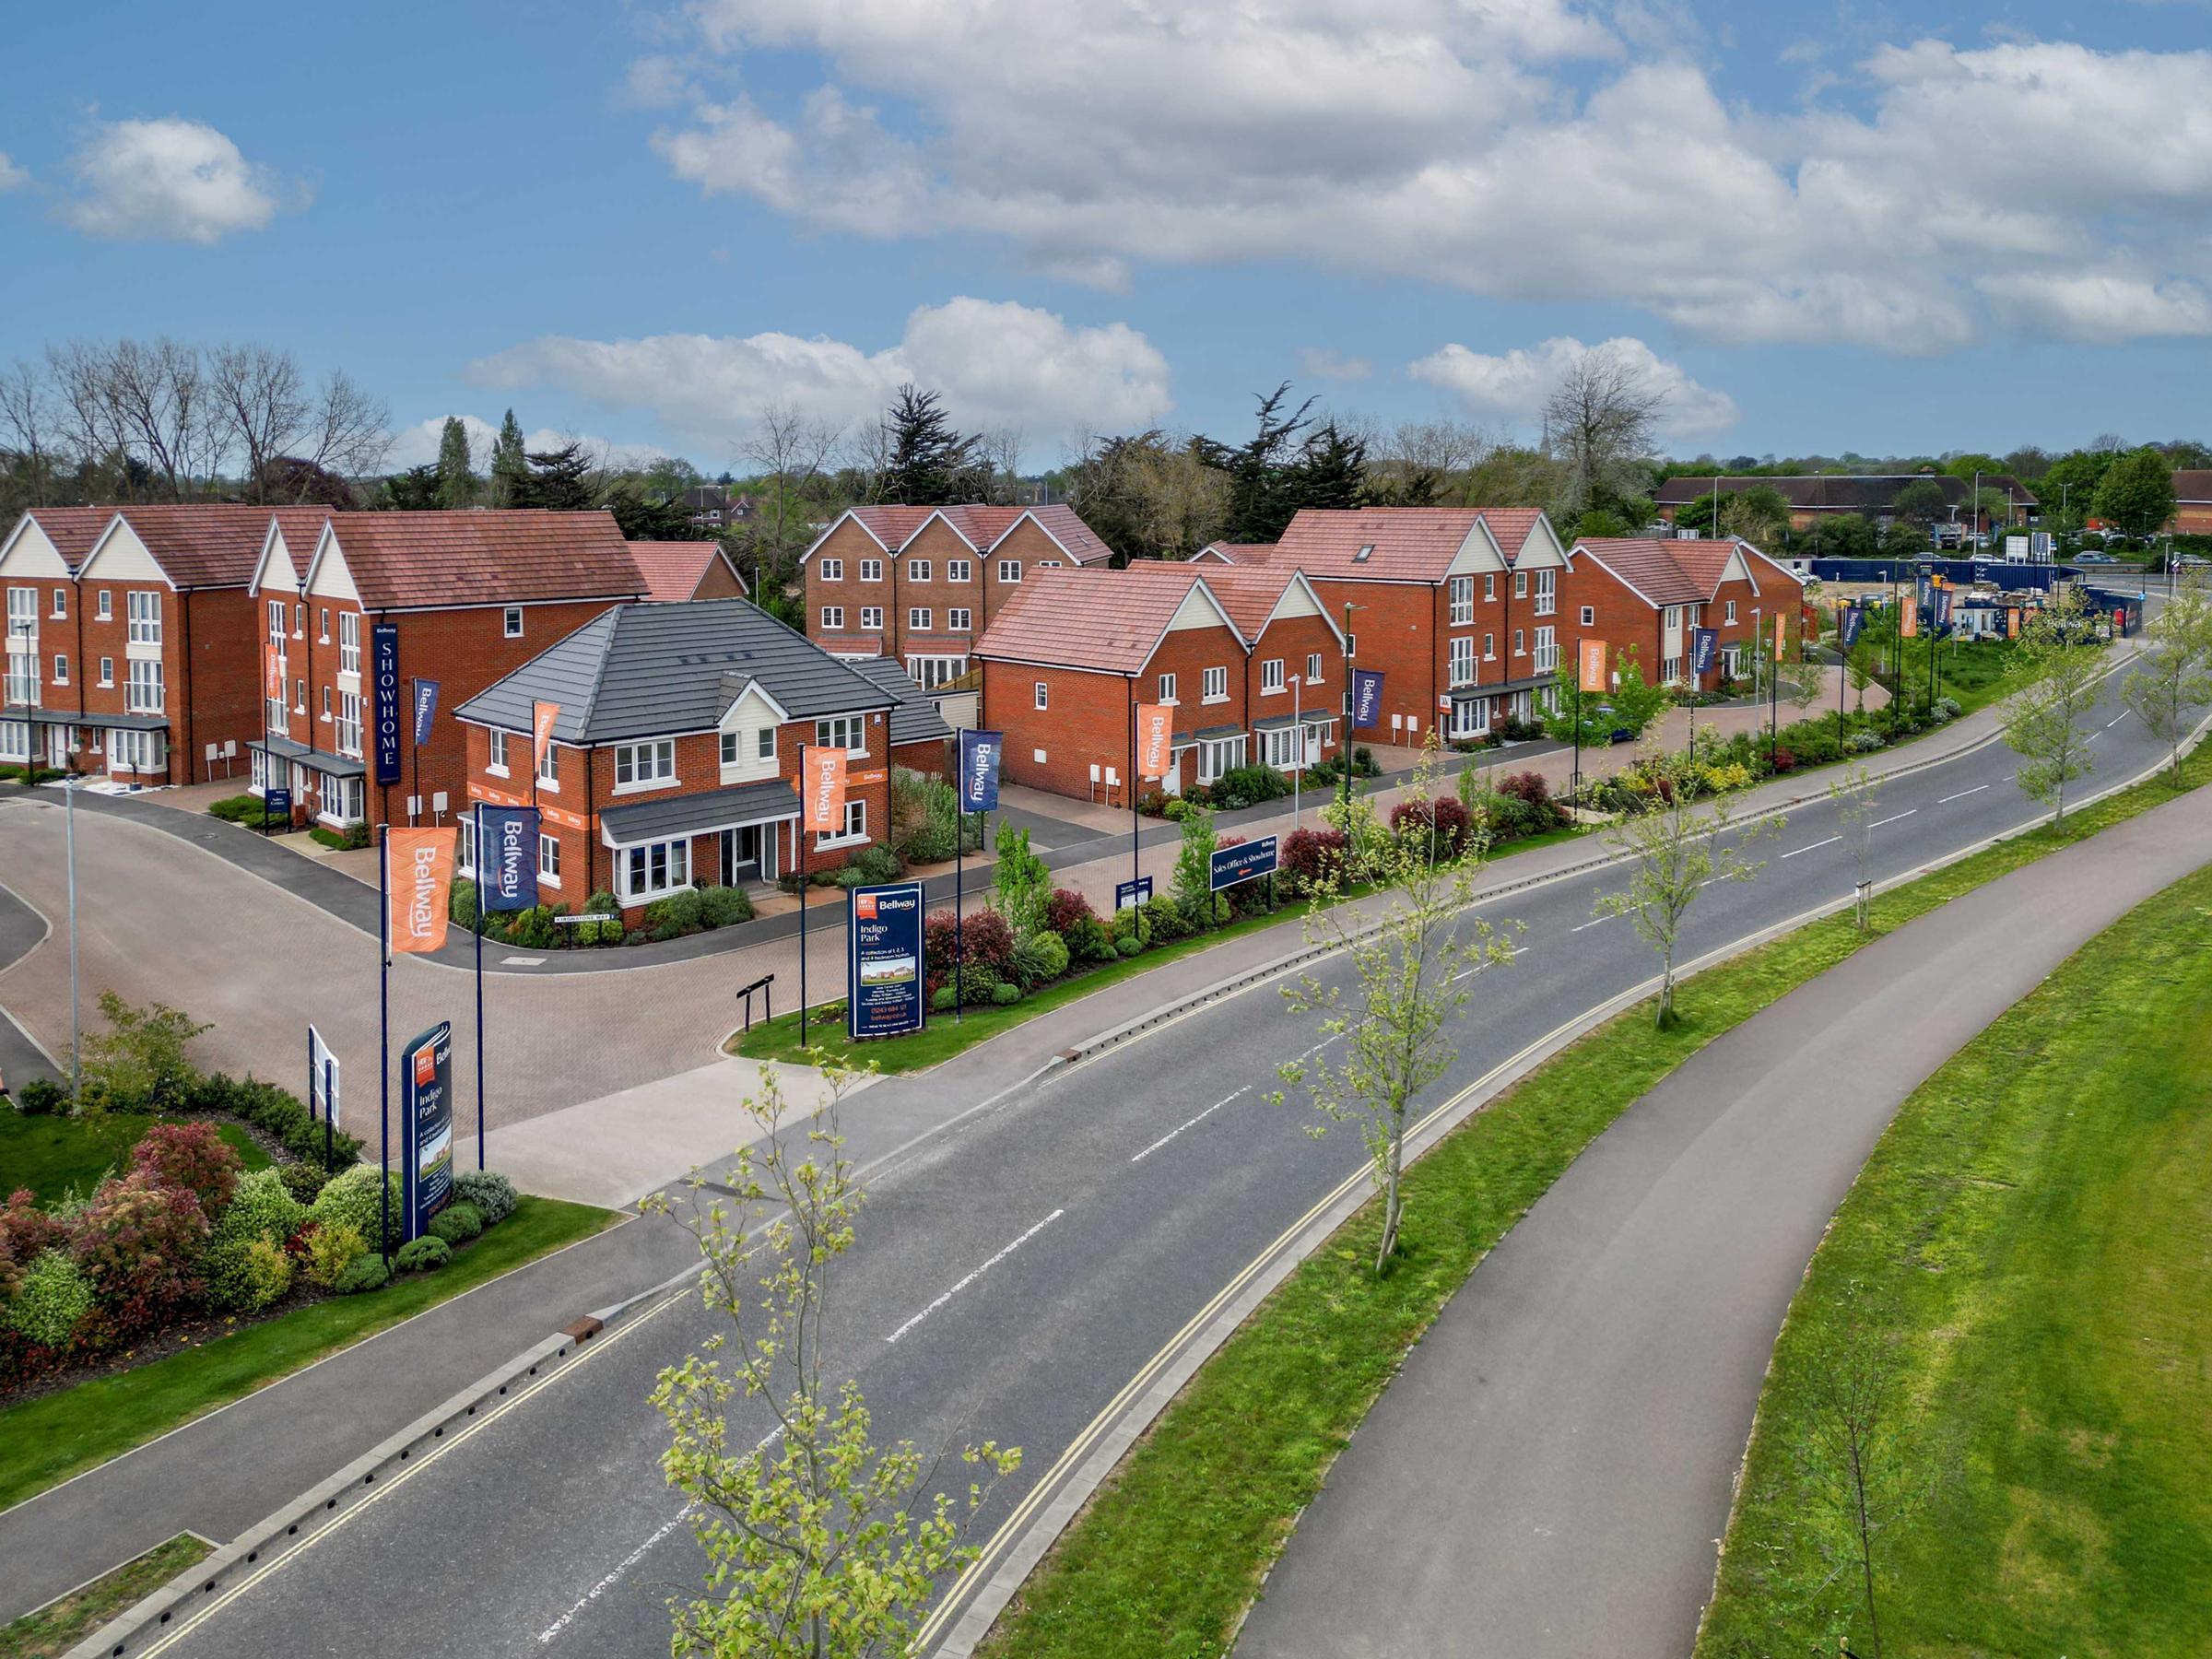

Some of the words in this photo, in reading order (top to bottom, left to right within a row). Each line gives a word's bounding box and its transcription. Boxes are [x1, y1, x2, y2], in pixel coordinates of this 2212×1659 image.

[1697, 635, 1712, 668] Bellway
[380, 642, 395, 765] SHOWHOME
[1358, 679, 1375, 721] Bellway
[1147, 716, 1165, 768] Bellway
[816, 759, 836, 822] Bellway
[971, 743, 992, 801] Bellway
[500, 820, 523, 899] Bellway
[1213, 863, 1227, 875] Sales
[1227, 858, 1243, 870] Office
[1248, 850, 1276, 864] Showhome
[410, 846, 437, 937] Bellway
[879, 899, 915, 911] Bellway
[860, 924, 888, 934] Indigo
[860, 934, 881, 943] Park
[419, 1085, 443, 1107] Indigo
[419, 1103, 438, 1120] Park
